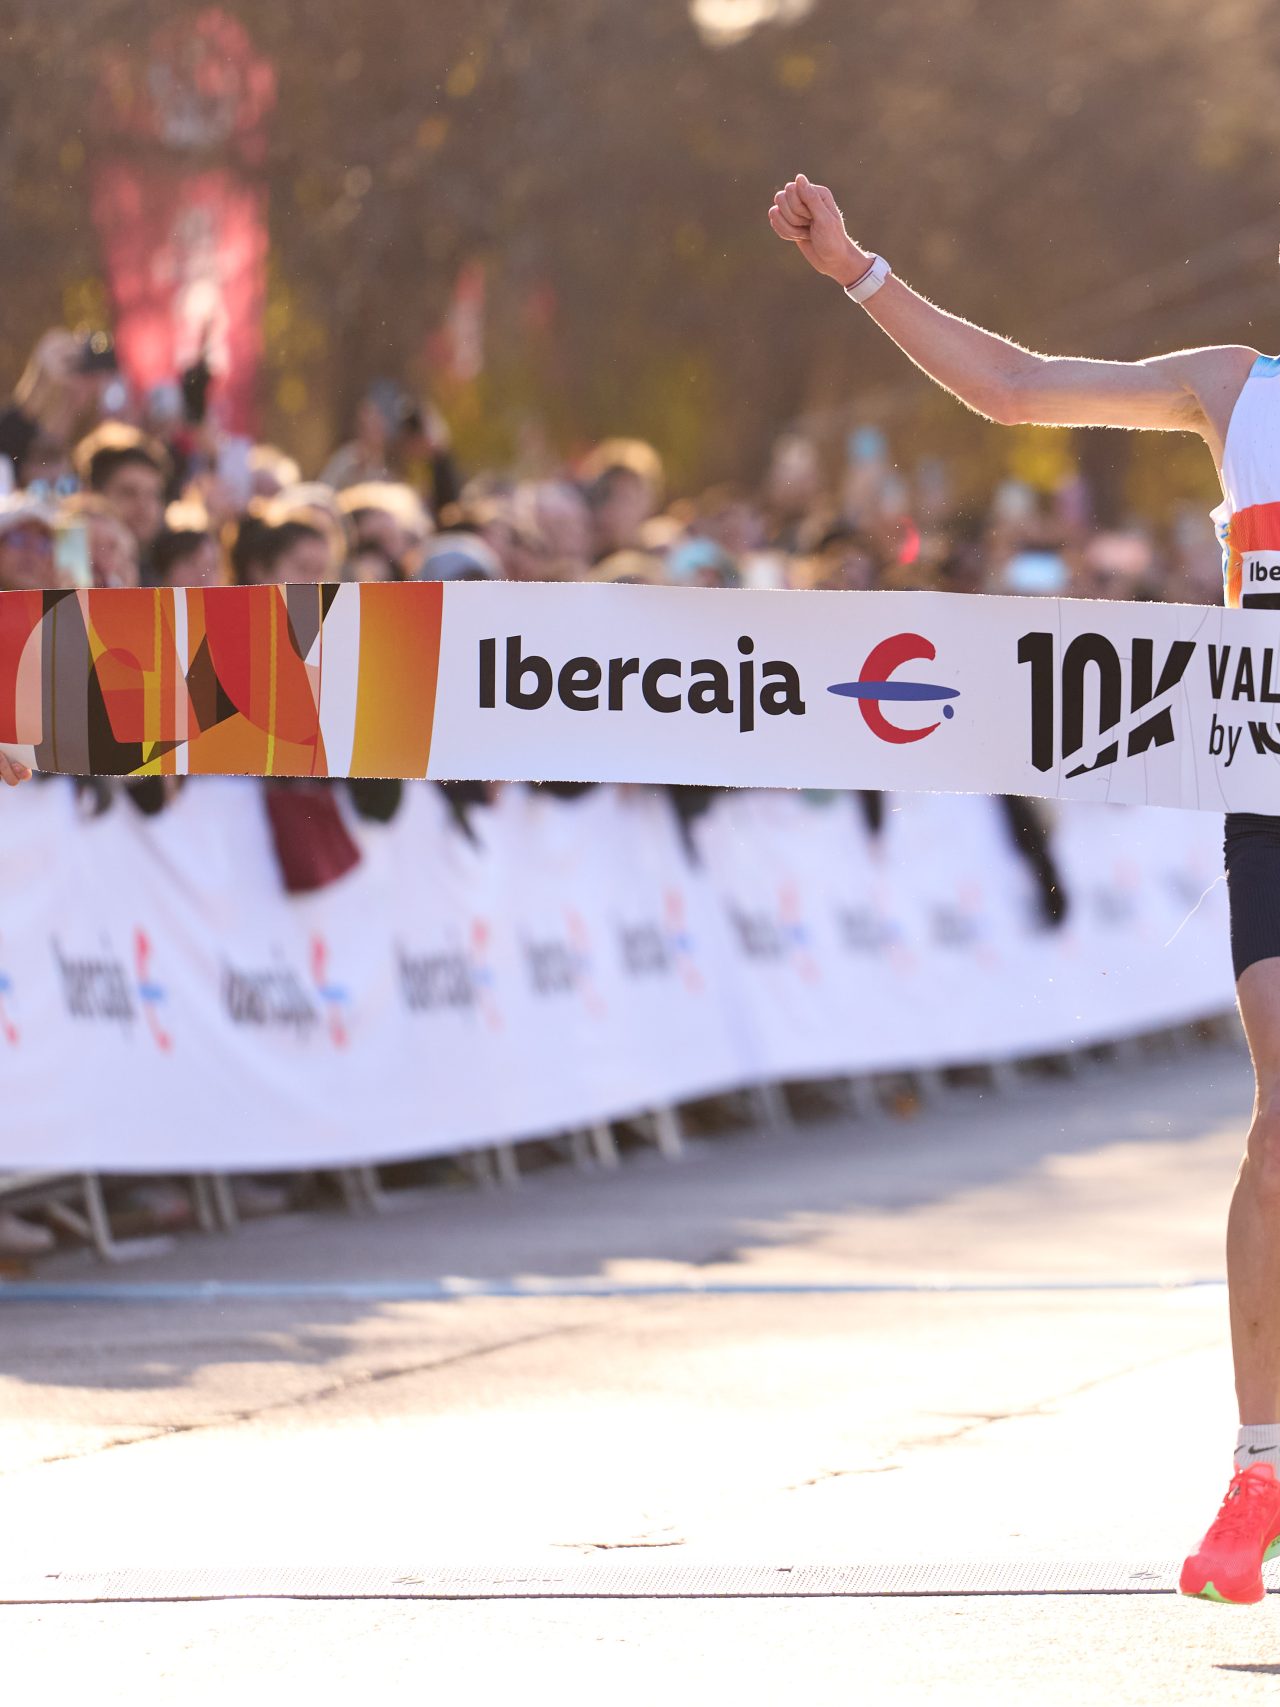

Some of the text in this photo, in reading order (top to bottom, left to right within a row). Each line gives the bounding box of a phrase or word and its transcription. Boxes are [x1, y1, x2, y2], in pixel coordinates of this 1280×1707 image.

[479, 635, 806, 733] Ibercaja
[1017, 631, 1197, 780] 10K
[1208, 713, 1243, 768] by
